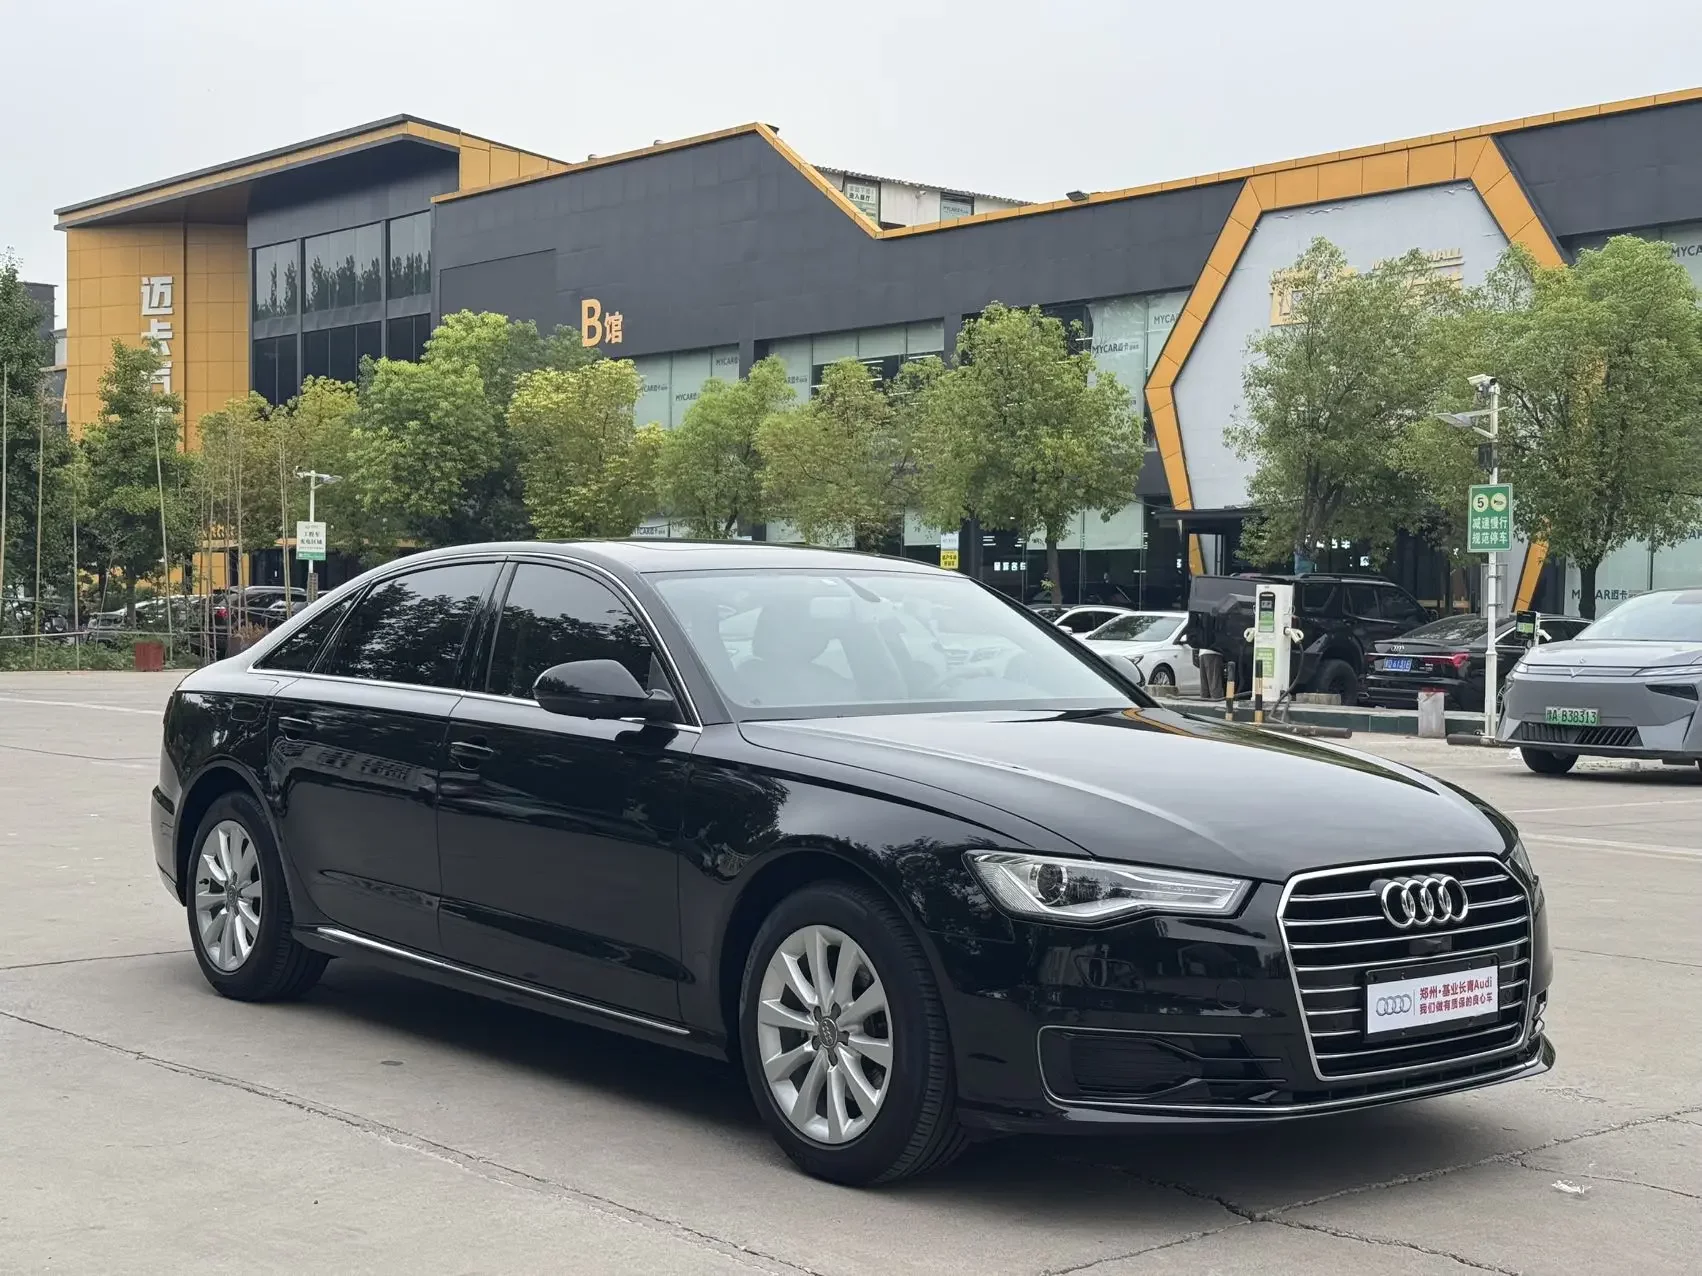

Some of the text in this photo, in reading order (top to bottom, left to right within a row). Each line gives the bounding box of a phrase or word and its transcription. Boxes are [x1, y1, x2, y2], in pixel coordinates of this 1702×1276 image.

[582, 299, 623, 347] B馆
[1477, 497, 1484, 508] 5
[1472, 516, 1508, 529] 减速慢行
[1472, 531, 1508, 544] 规范停车
[1572, 589, 1628, 600] MAR迈卡
[1420, 992, 1493, 1015] 我们做有质保的良心车
